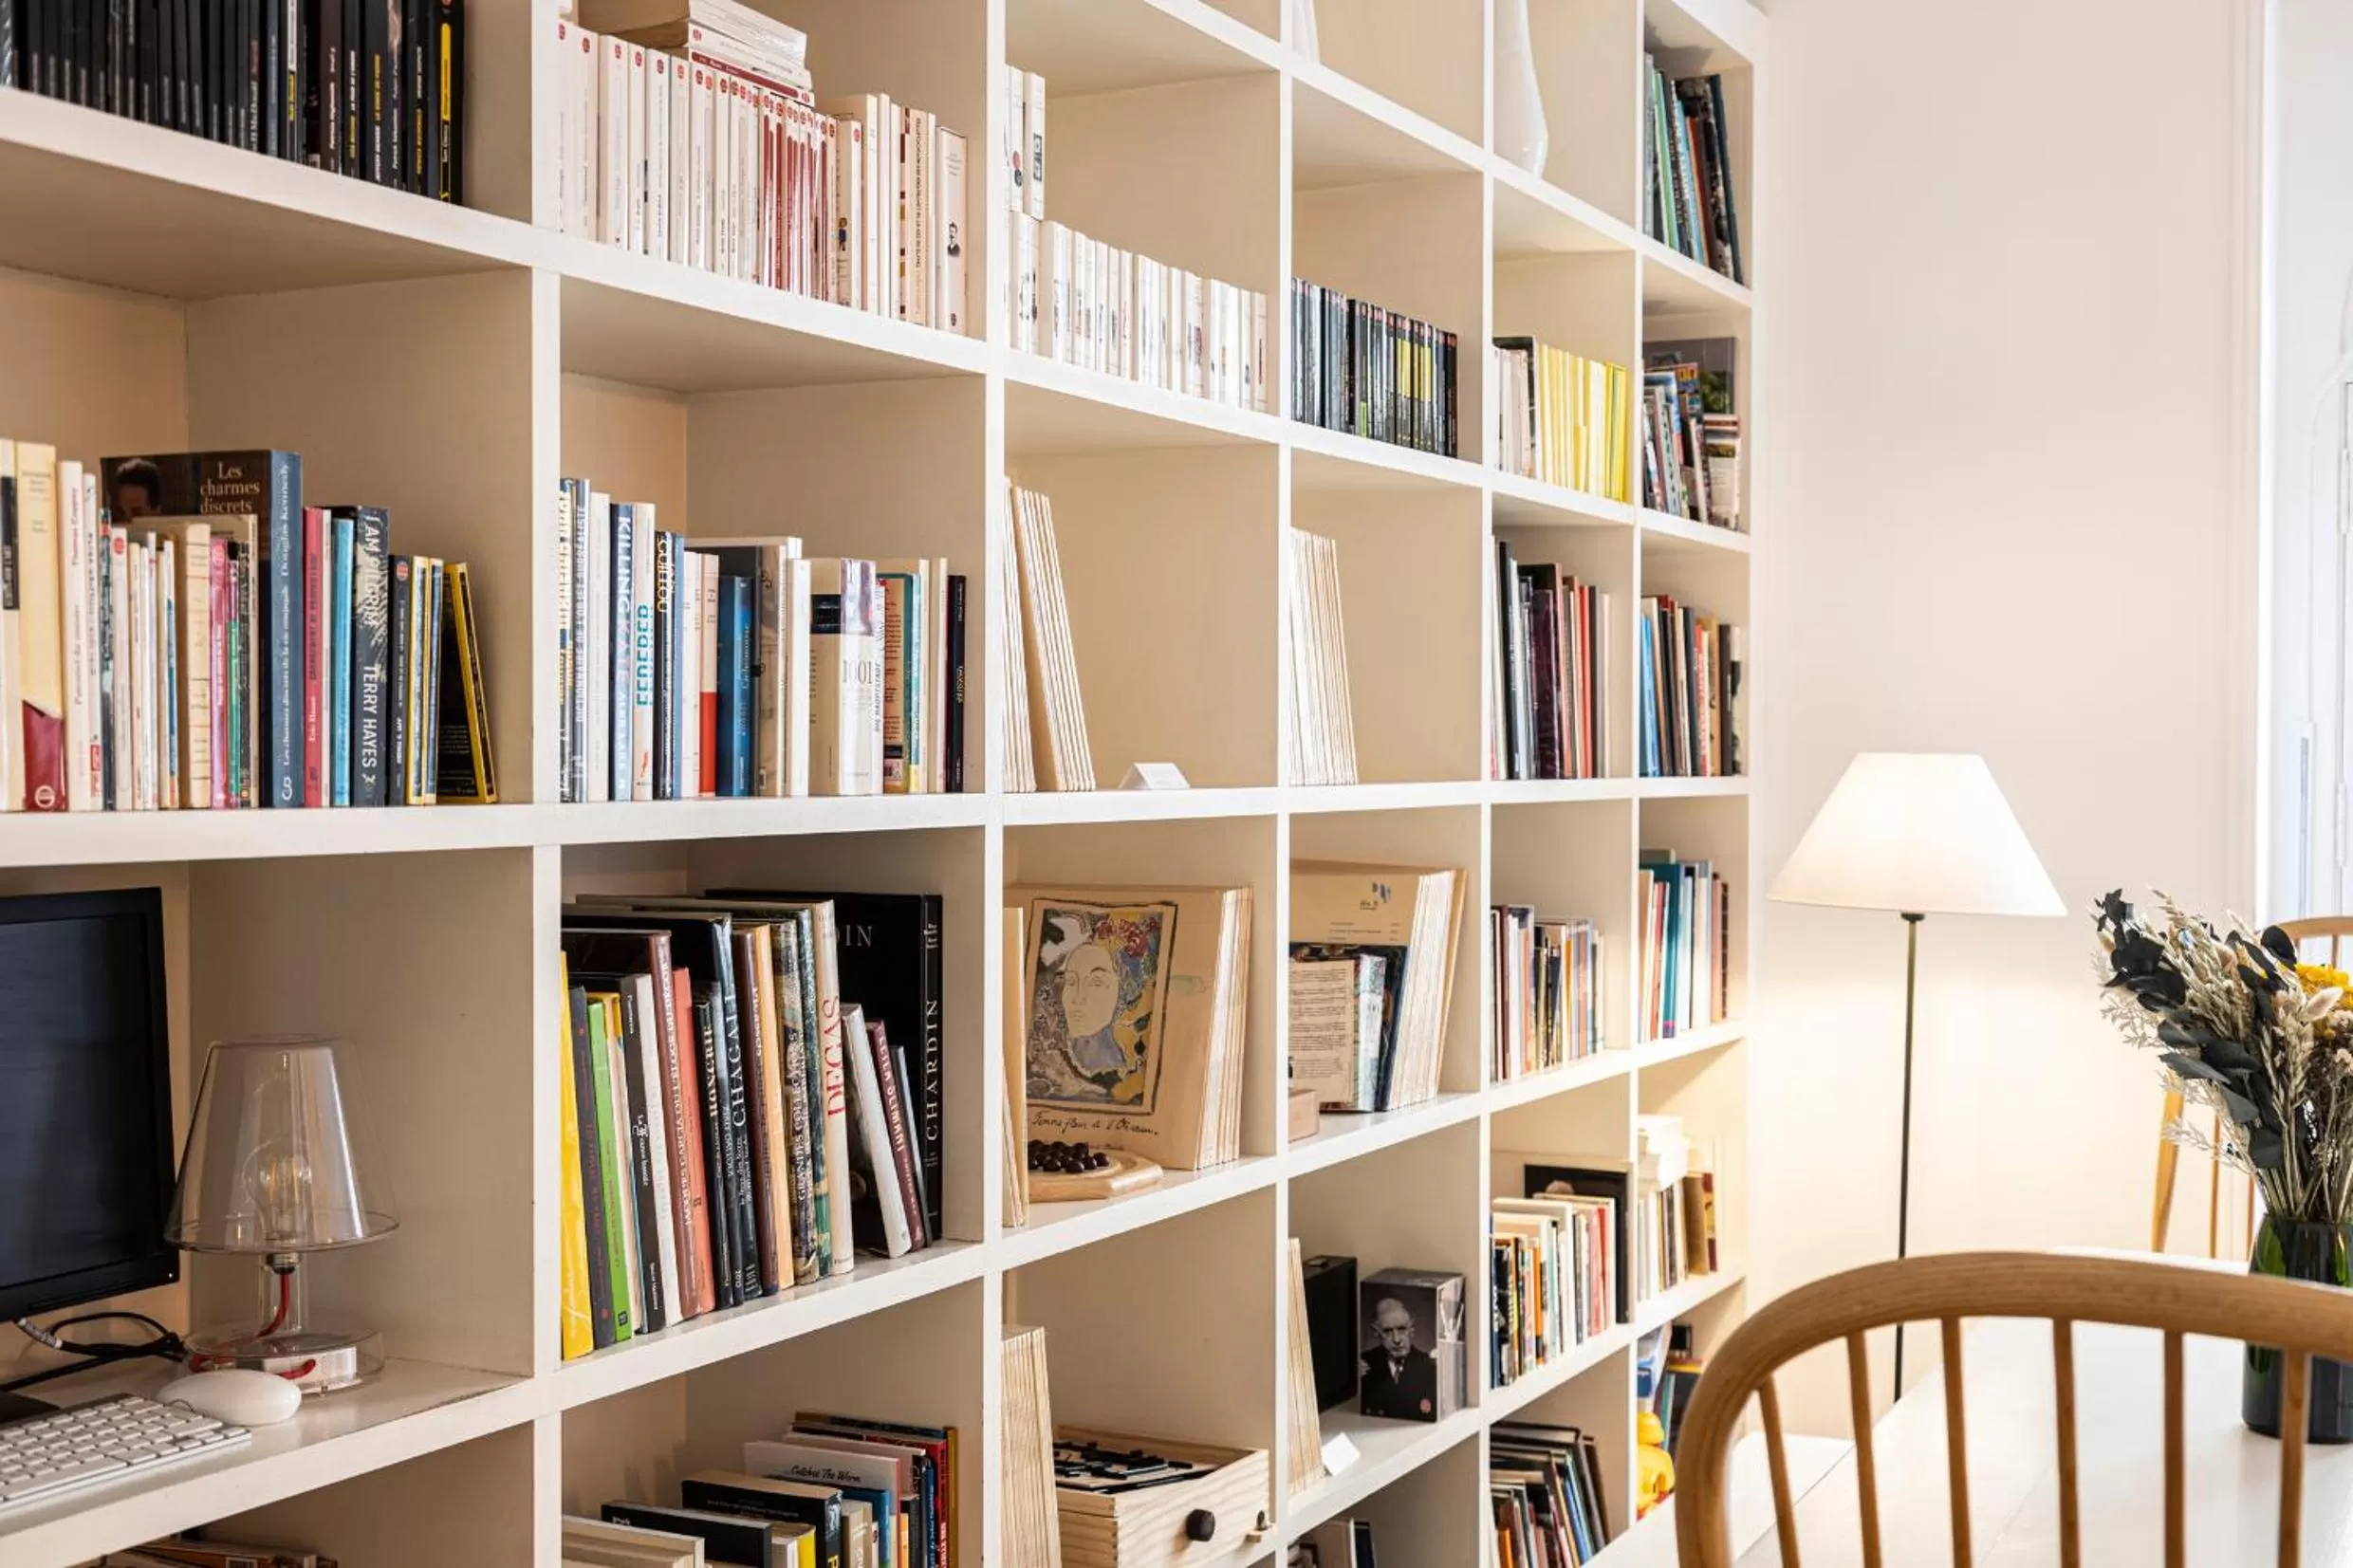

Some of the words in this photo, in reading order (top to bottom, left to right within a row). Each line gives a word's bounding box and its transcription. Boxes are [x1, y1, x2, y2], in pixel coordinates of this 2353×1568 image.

[200, 477, 261, 496] charmes
[218, 461, 243, 479] Les
[279, 464, 290, 520] Kennedy
[200, 497, 252, 513] discrets
[279, 522, 290, 577] Douglas
[365, 526, 381, 551] AM
[617, 515, 632, 614] KILLING
[280, 584, 290, 630] conjugale
[364, 555, 381, 626] PILGRIM
[618, 618, 632, 684] KATE
[637, 604, 653, 706] FEDERER
[281, 670, 289, 706] discrets
[362, 664, 378, 716] TERRY
[281, 709, 290, 747] charmes
[362, 719, 378, 767] HAYES
[617, 731, 628, 771] LAKE
[282, 748, 290, 766] Les
[703, 1024, 719, 1118] HONGRIE
[722, 983, 748, 1128] CHAGALL
[788, 1032, 804, 1131] COLLECTIONS
[822, 995, 846, 1117] DEGAS
[926, 1000, 938, 1141] CHARDIN
[879, 1036, 893, 1081] LEILA
[886, 1086, 905, 1152] SLIMANI
[673, 1116, 688, 1165] GARCIA
[793, 1134, 807, 1202] GRANDES
[676, 1170, 693, 1227] JACQUES
[822, 1467, 835, 1480] The
[837, 1469, 862, 1482] Worm
